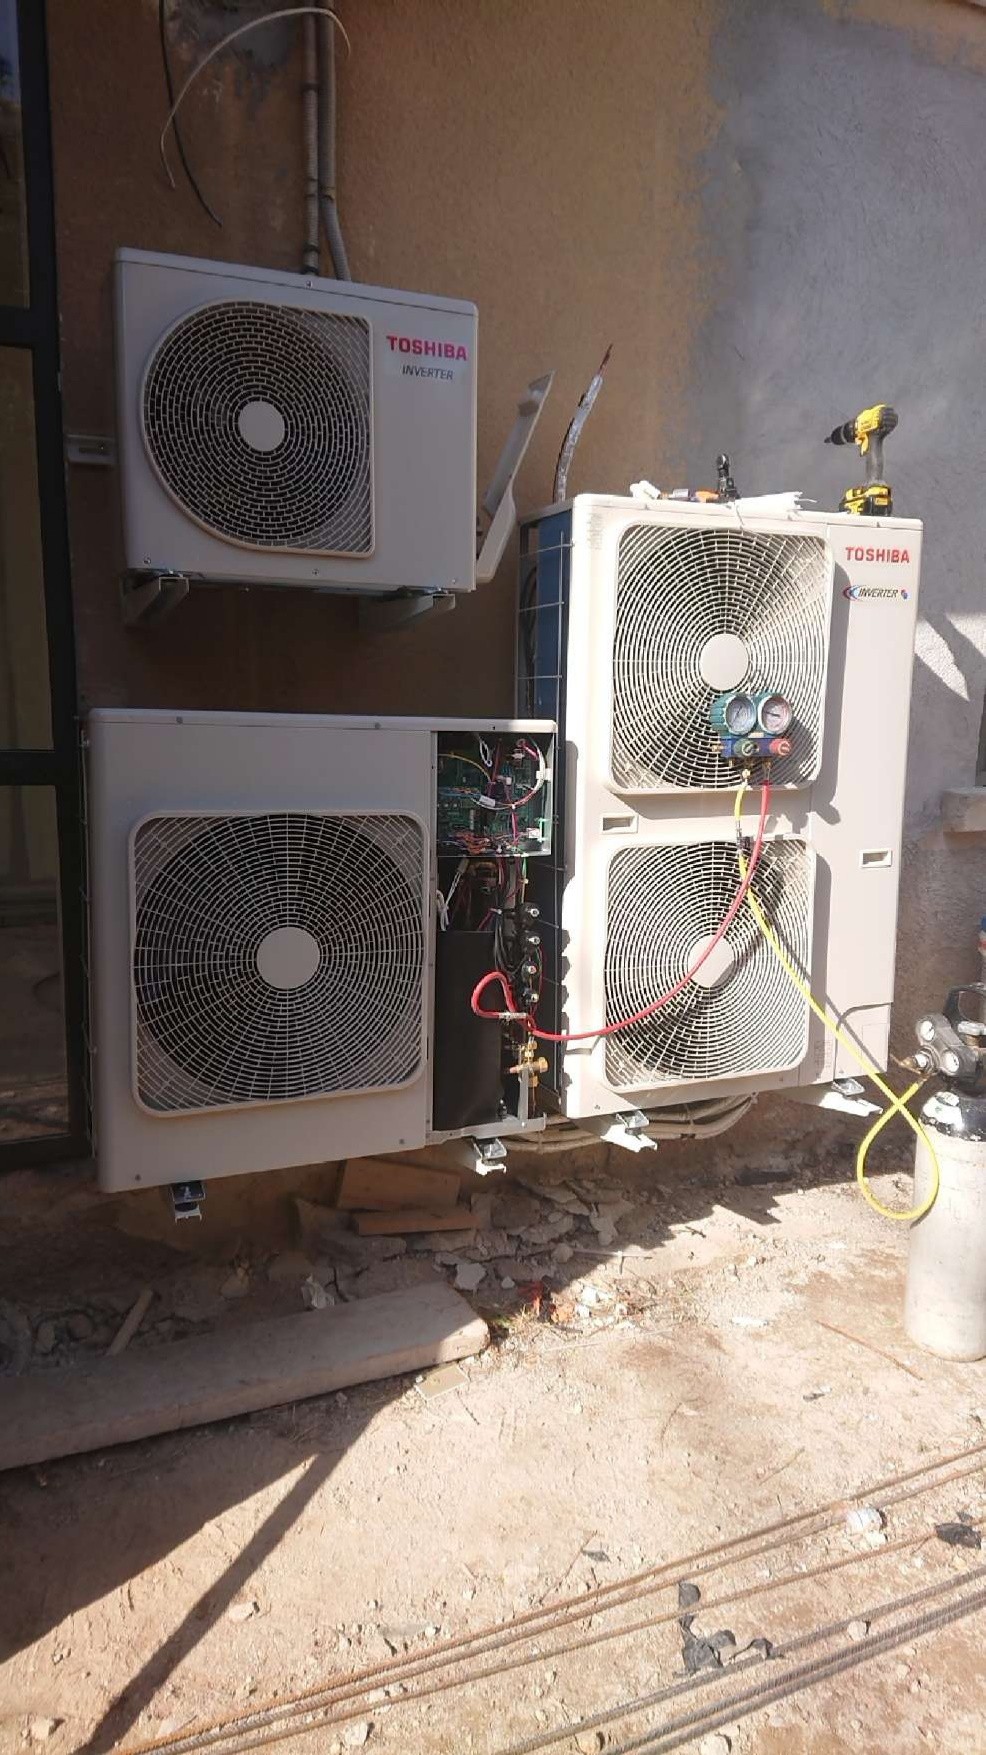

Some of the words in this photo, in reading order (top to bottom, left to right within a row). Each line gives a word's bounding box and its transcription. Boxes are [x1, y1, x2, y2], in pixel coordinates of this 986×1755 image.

[386, 335, 467, 361] TOSHIBA
[402, 364, 454, 380] INVERTER
[845, 546, 910, 563] TOSHIBA
[858, 587, 898, 598] INVERTER
